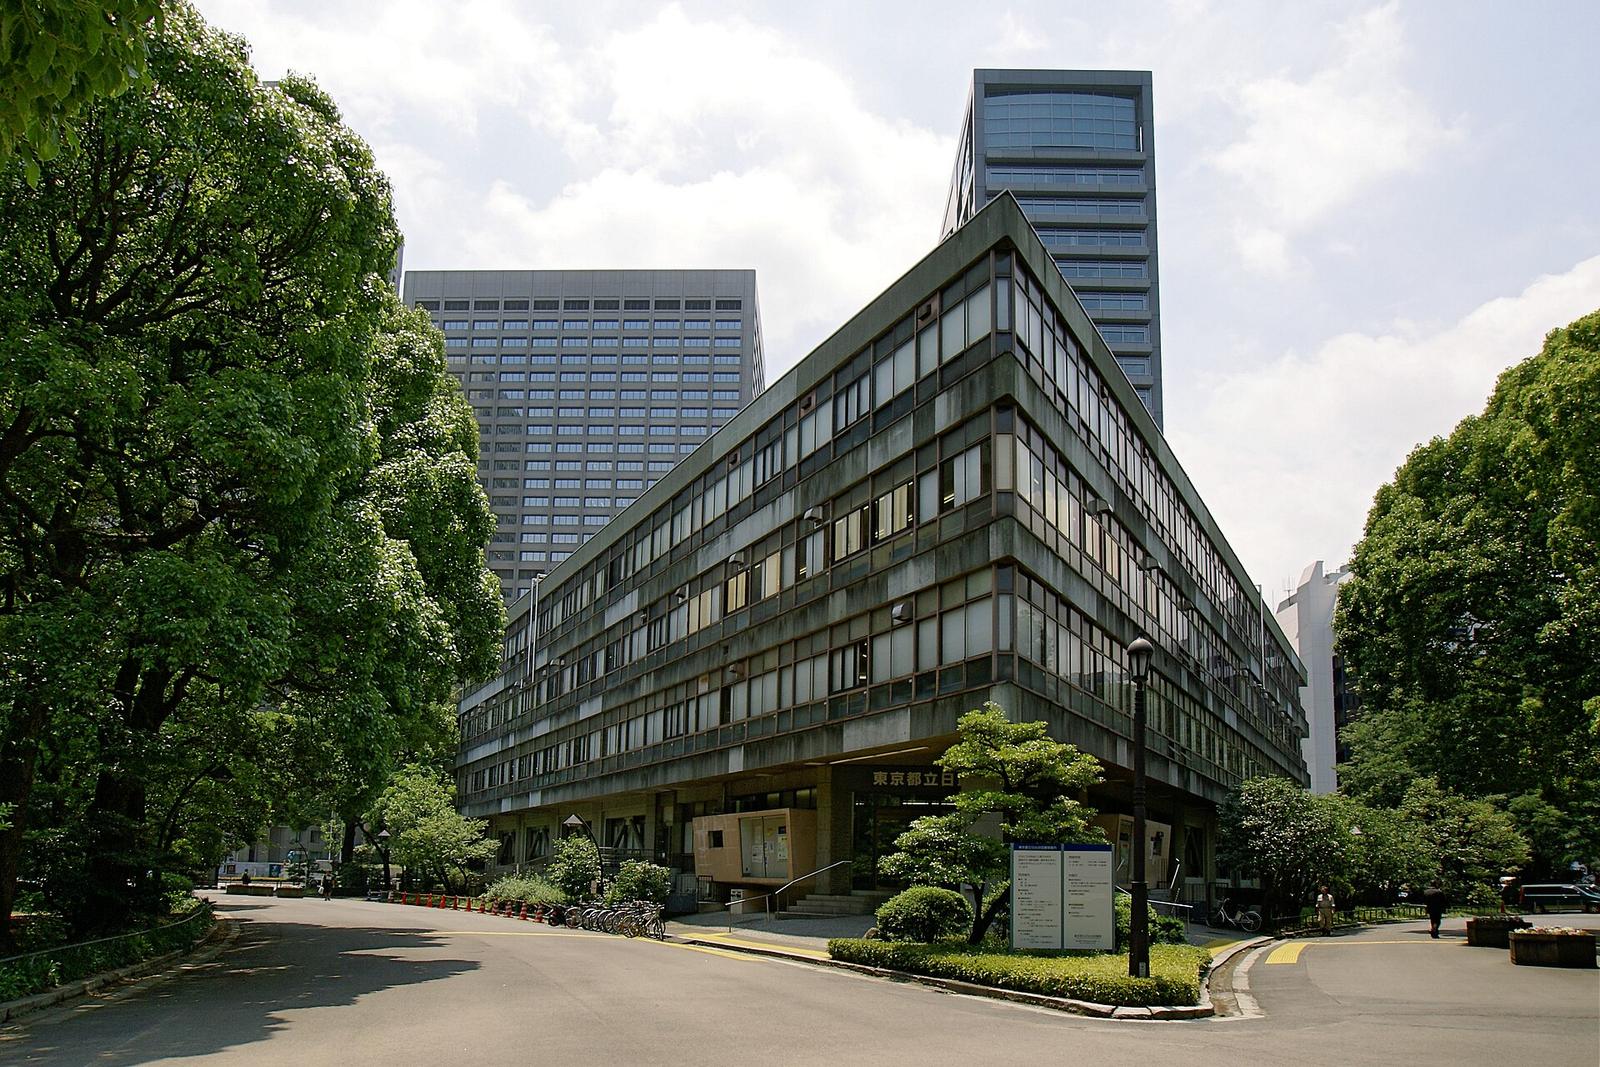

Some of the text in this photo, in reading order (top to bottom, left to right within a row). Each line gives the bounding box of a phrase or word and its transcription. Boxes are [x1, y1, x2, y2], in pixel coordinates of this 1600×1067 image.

[873, 771, 960, 786] 東京都立日
